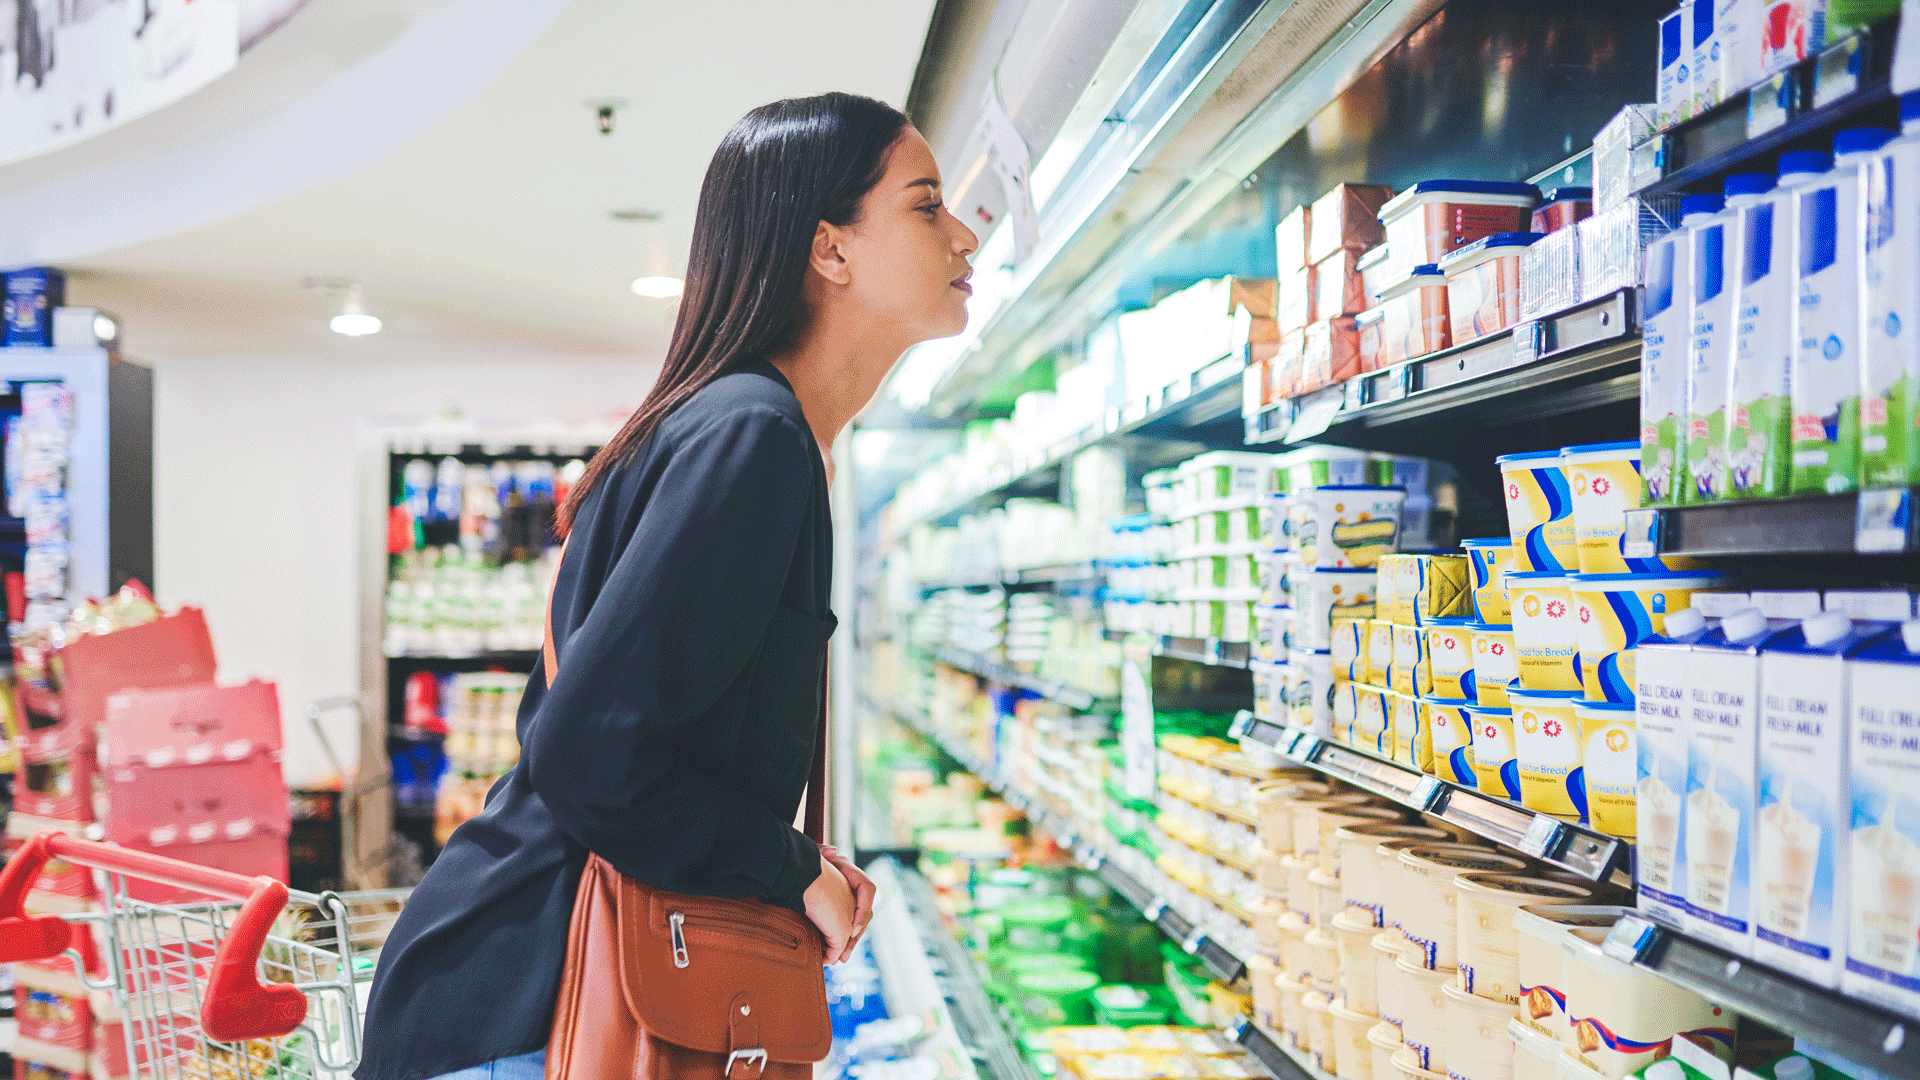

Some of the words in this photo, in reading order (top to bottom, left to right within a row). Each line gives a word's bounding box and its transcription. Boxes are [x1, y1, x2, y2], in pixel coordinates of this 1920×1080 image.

[1592, 526, 1620, 538] Bread
[1545, 646, 1574, 657] Bread
[1639, 683, 1653, 697] FULL
[1655, 685, 1683, 700] CREAM
[1692, 688, 1709, 703] FULL
[1711, 690, 1744, 708] CREAM
[1640, 701, 1660, 716] FRESH
[1661, 704, 1681, 719] MILK
[1766, 695, 1784, 711] FULL
[1788, 697, 1829, 716] CREAM
[1693, 708, 1717, 723] FRESH
[1719, 713, 1741, 728] MILK
[1859, 706, 1884, 724] FULL
[1766, 716, 1794, 732] FRESH
[1796, 721, 1824, 738] MILK
[1540, 765, 1568, 775] Bread
[1591, 783, 1615, 795] Spread
[1616, 785, 1631, 796] for
[1651, 869, 1668, 885] Litres
[1510, 995, 1519, 1005] kg
